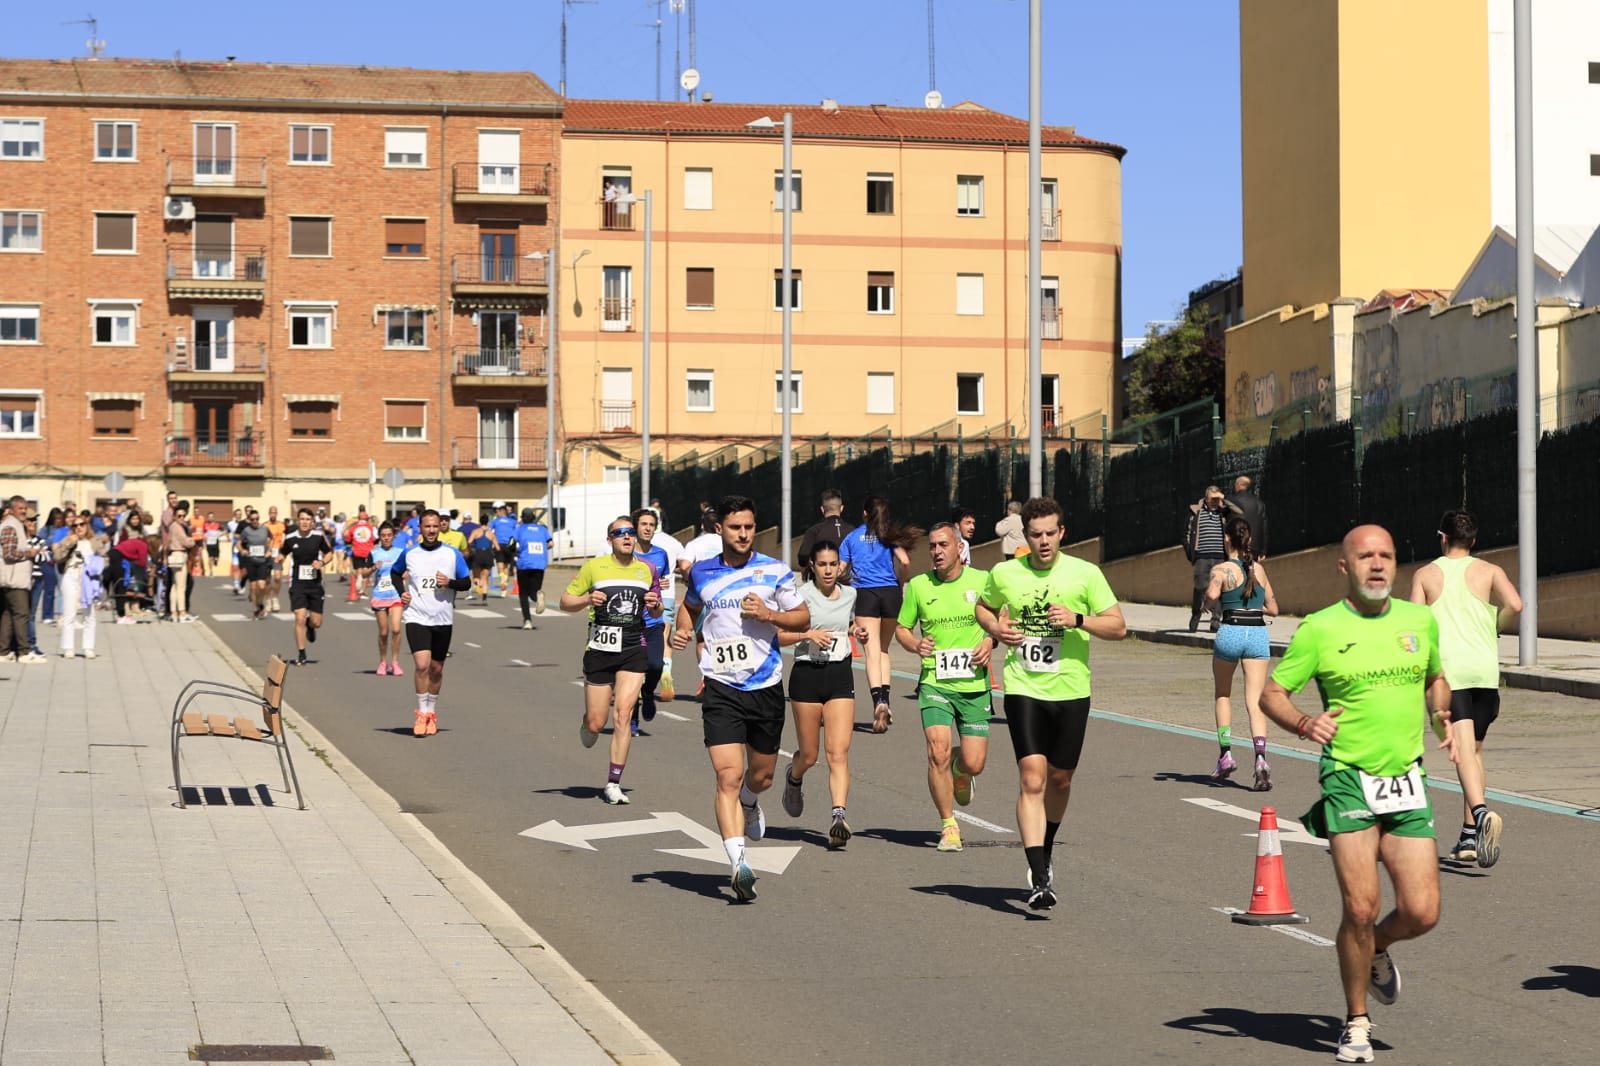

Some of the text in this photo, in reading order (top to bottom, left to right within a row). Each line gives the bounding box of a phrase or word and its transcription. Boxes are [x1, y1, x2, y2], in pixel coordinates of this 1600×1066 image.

[422, 578, 436, 589] 22
[704, 598, 742, 609] RABAY
[594, 630, 617, 645] 206
[716, 643, 748, 664] 318
[1020, 643, 1054, 664] 162
[941, 655, 969, 671] 147
[1371, 773, 1415, 801] 241
